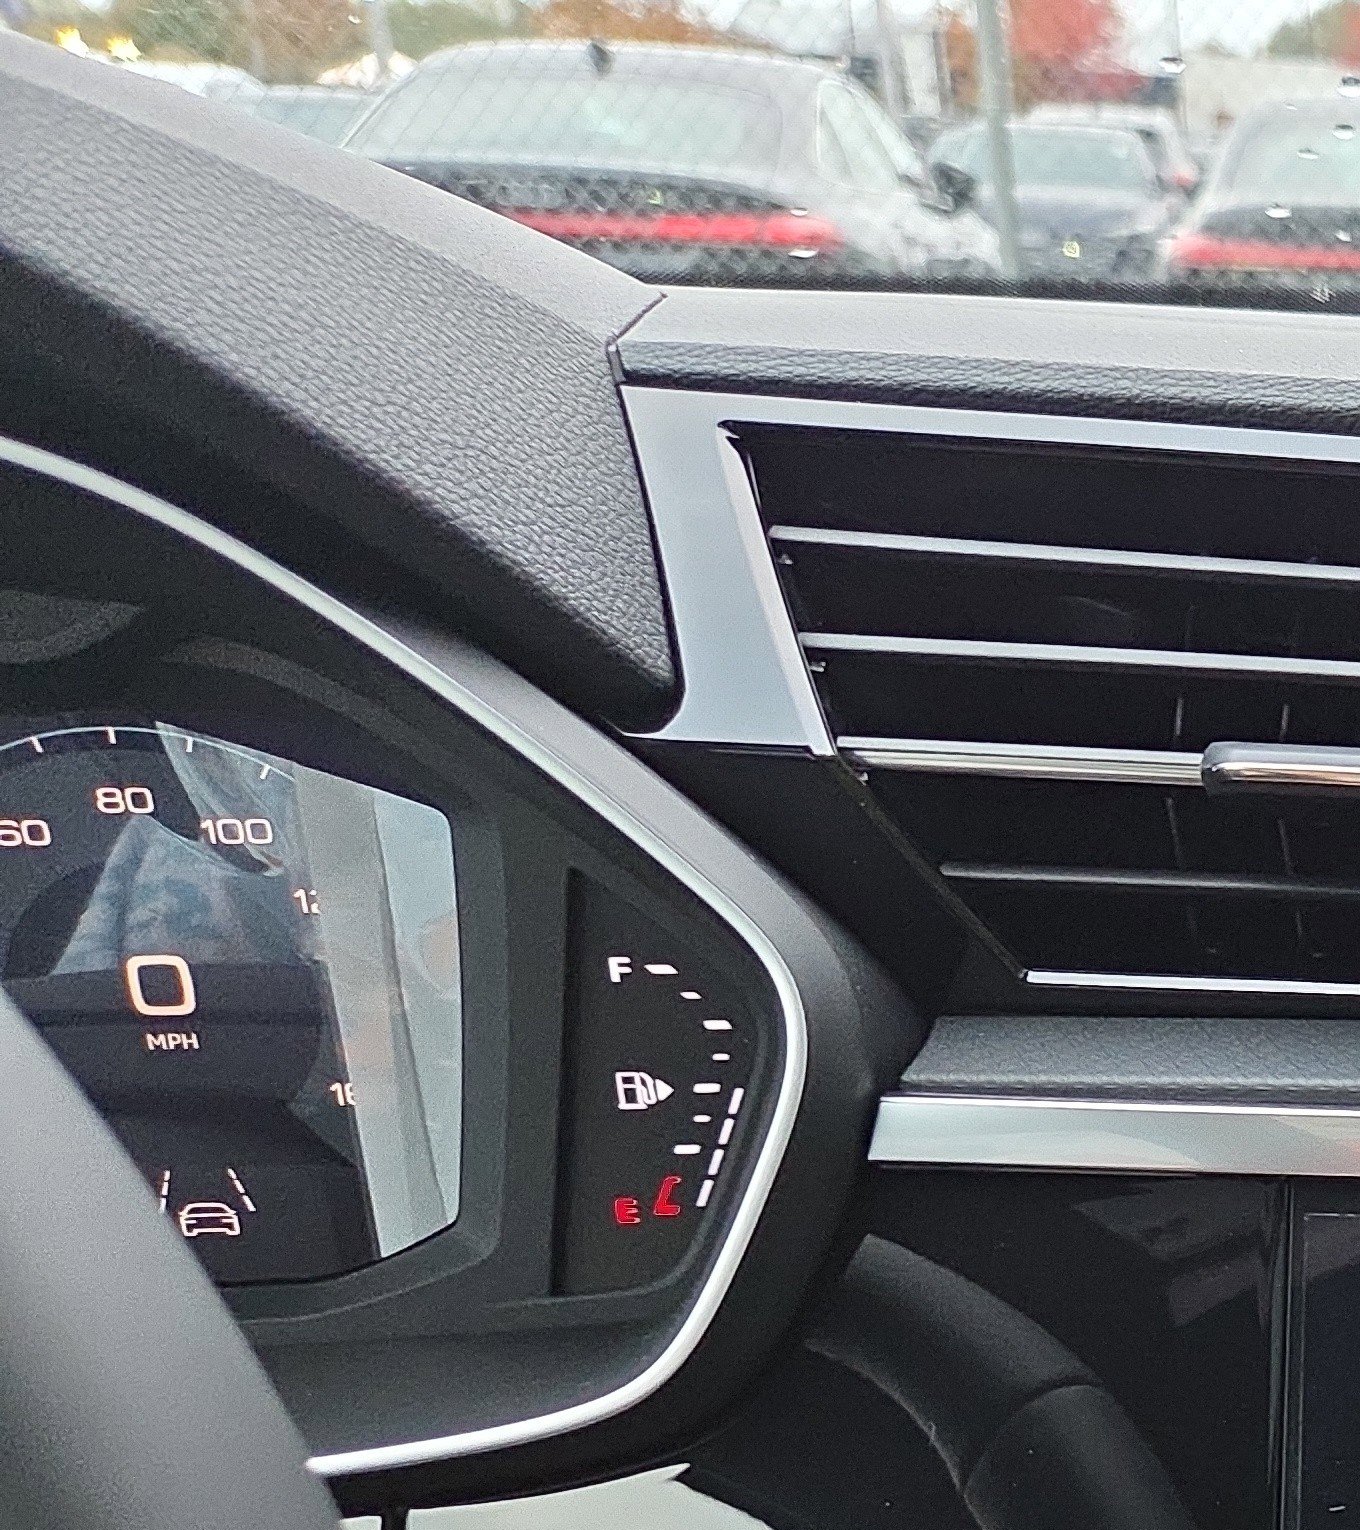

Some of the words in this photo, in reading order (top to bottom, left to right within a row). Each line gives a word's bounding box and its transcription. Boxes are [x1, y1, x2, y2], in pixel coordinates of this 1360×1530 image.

[96, 787, 154, 814] 80
[200, 818, 273, 845] 100
[607, 956, 633, 983] F
[126, 954, 196, 1016] 0
[146, 1032, 199, 1051] MPH
[614, 1197, 641, 1224] E
